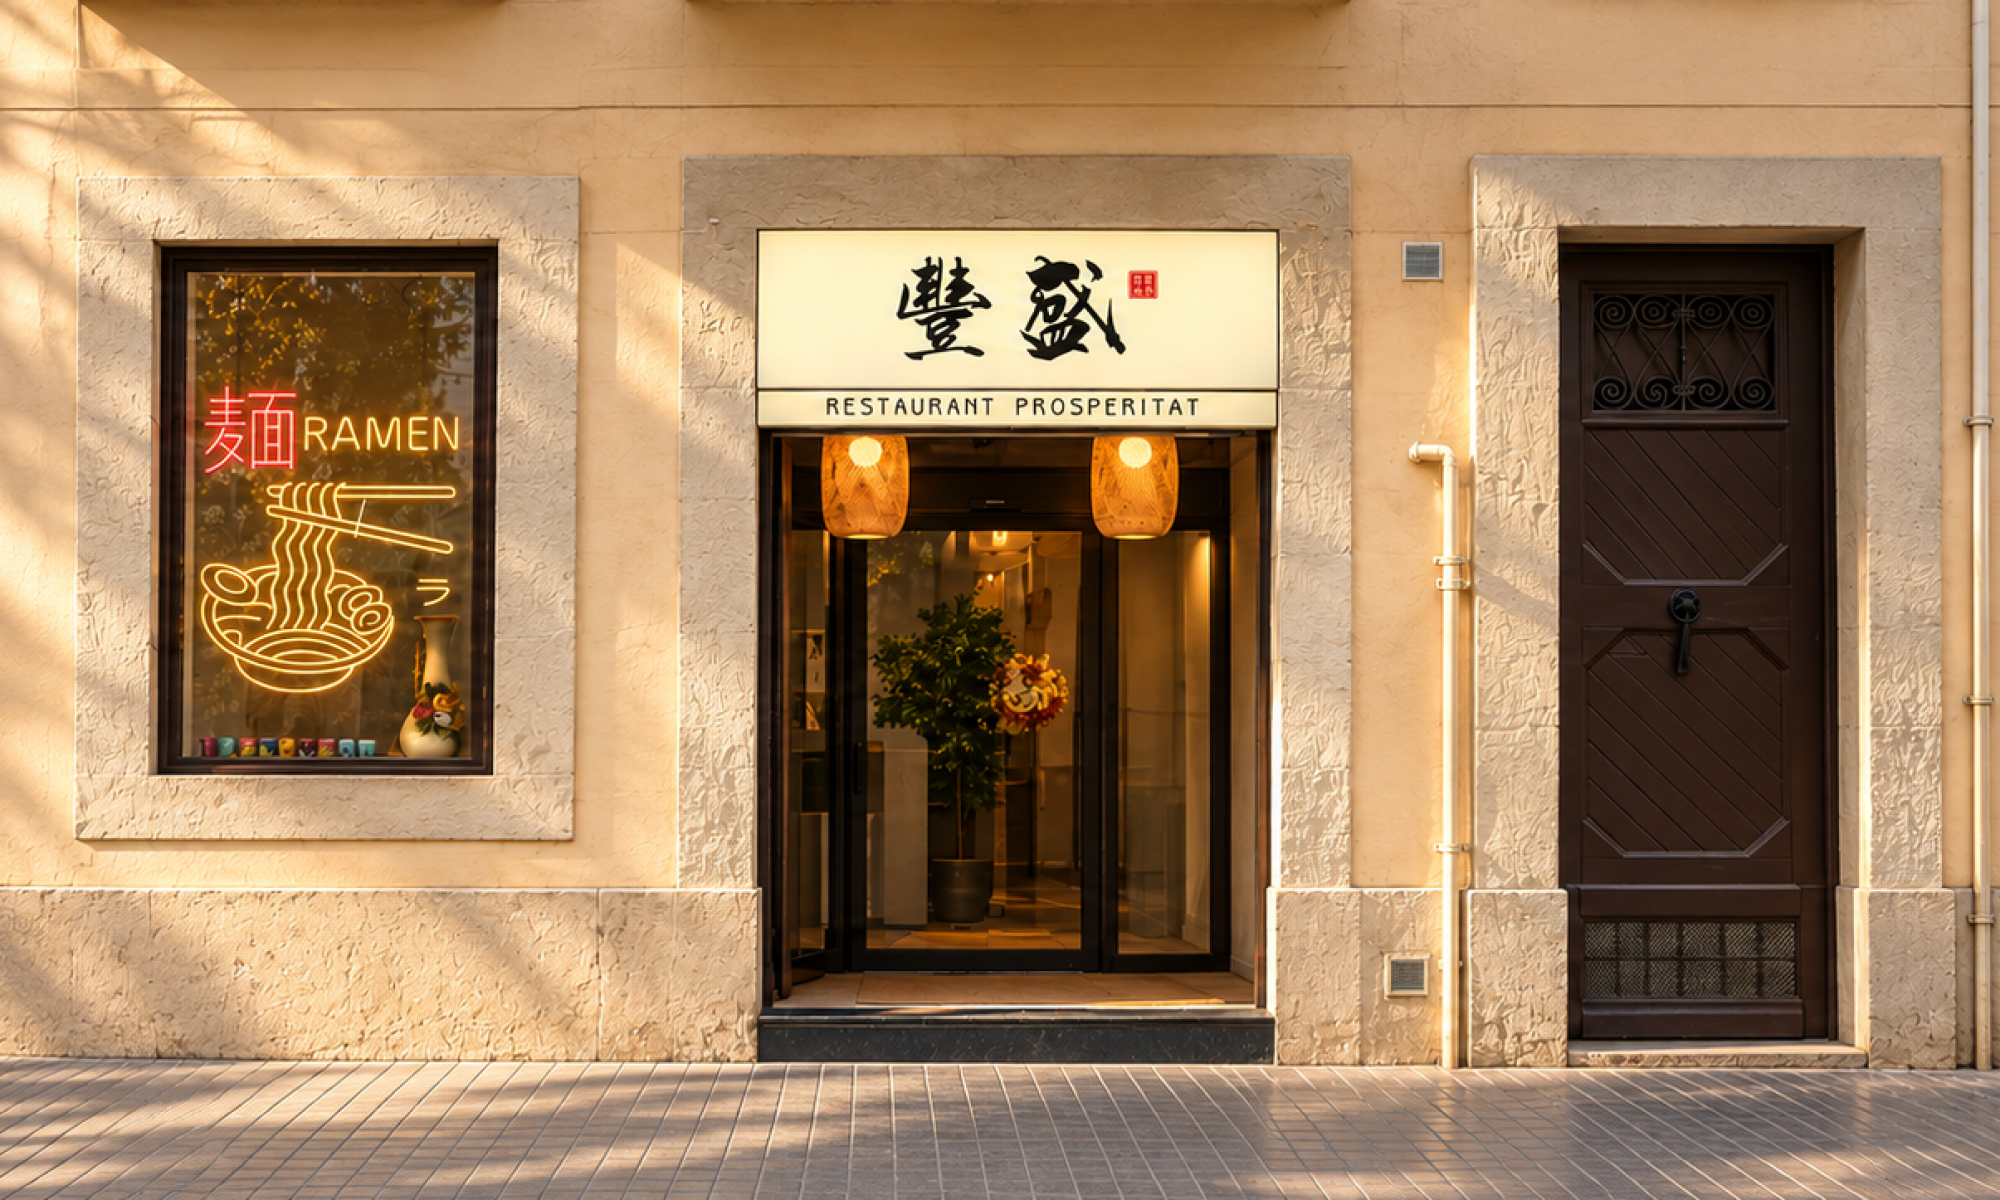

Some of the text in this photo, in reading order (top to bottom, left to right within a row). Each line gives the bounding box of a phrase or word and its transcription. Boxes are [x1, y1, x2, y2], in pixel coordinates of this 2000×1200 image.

[897, 255, 1126, 361] 豐盛
[826, 397, 1200, 416] RESTAURANT PROSPERITAT
[303, 415, 460, 451] RAMEN
